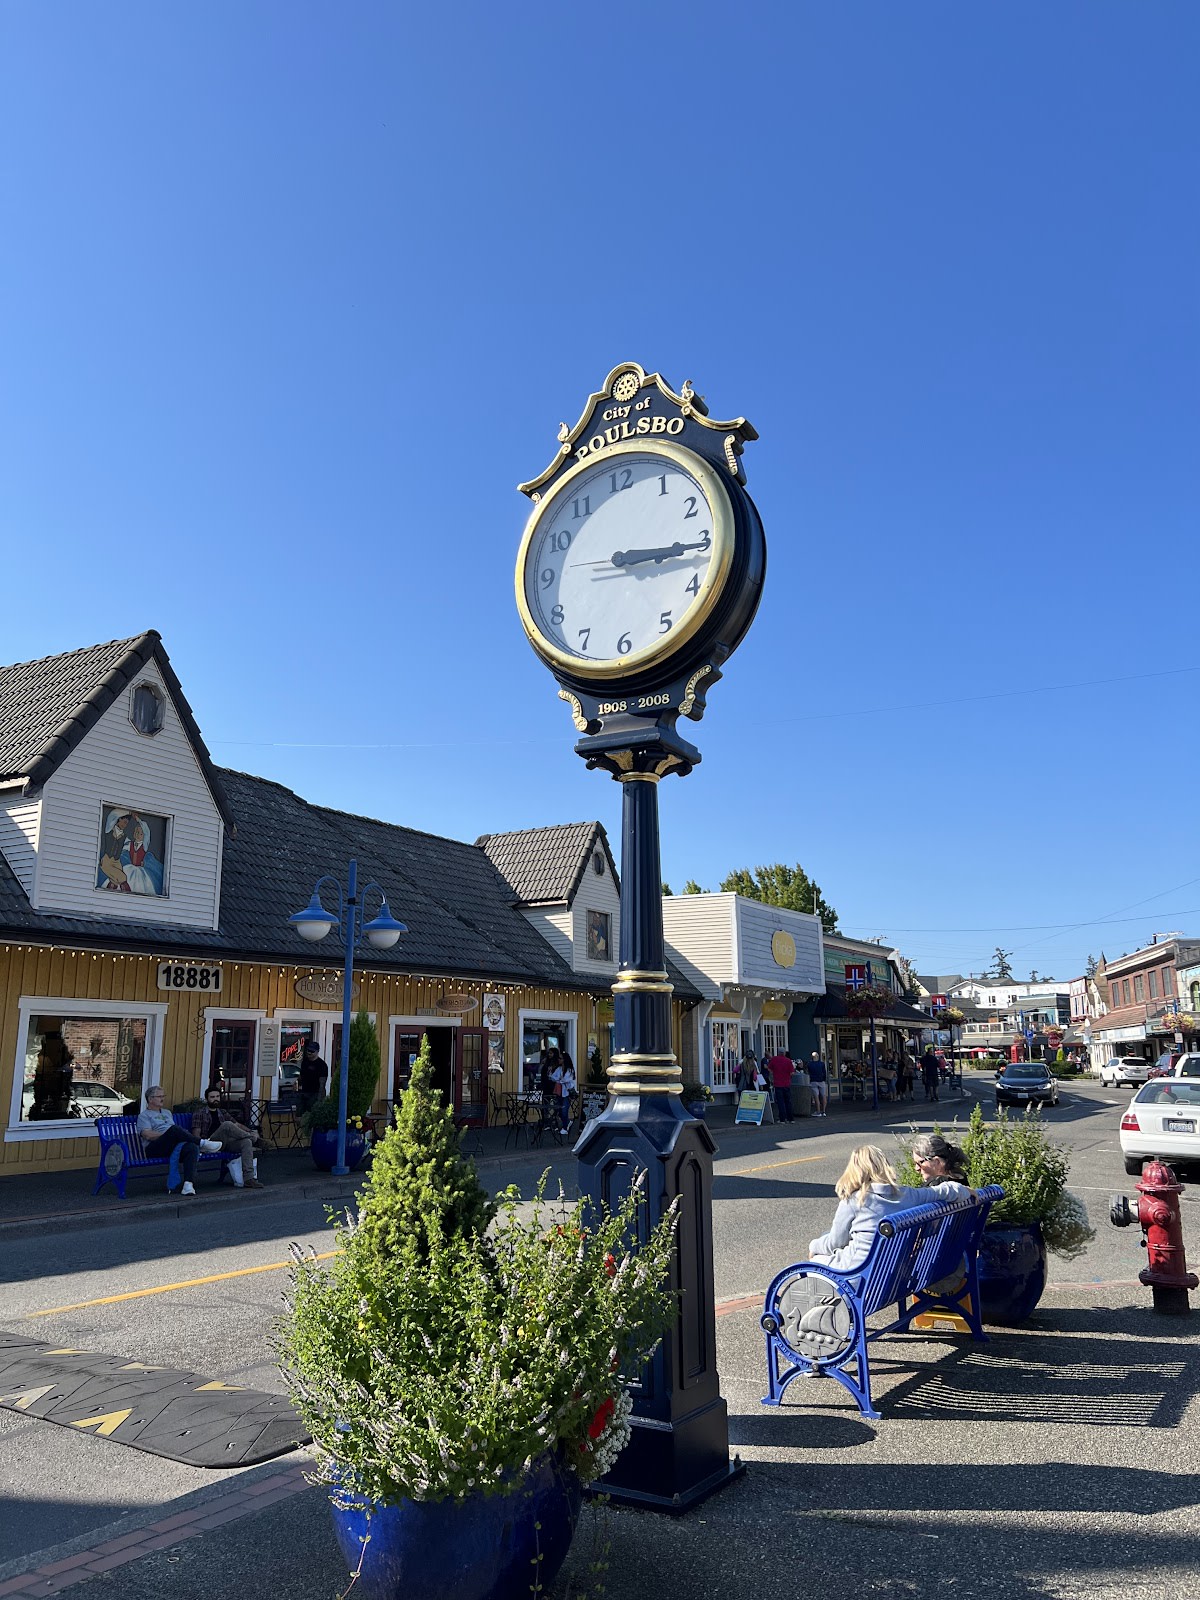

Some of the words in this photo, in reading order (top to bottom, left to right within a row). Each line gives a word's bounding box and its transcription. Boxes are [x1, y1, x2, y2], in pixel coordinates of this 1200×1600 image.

[602, 404, 632, 421] City
[635, 397, 651, 411] of
[574, 416, 685, 461] POULSBO
[609, 468, 634, 494] 12
[658, 474, 669, 497] 1
[571, 495, 593, 520] 11
[683, 496, 699, 519] 2
[549, 530, 572, 553] 10
[698, 529, 711, 552] 3
[540, 568, 555, 590] 9
[684, 573, 701, 597] 4
[550, 604, 565, 626] 8
[658, 610, 673, 634] 5
[578, 627, 591, 651] 7
[616, 631, 632, 655] 6
[598, 700, 628, 715] 1908
[638, 693, 670, 708] 2008
[162, 965, 220, 990] 18881
[300, 981, 316, 992] HOT
